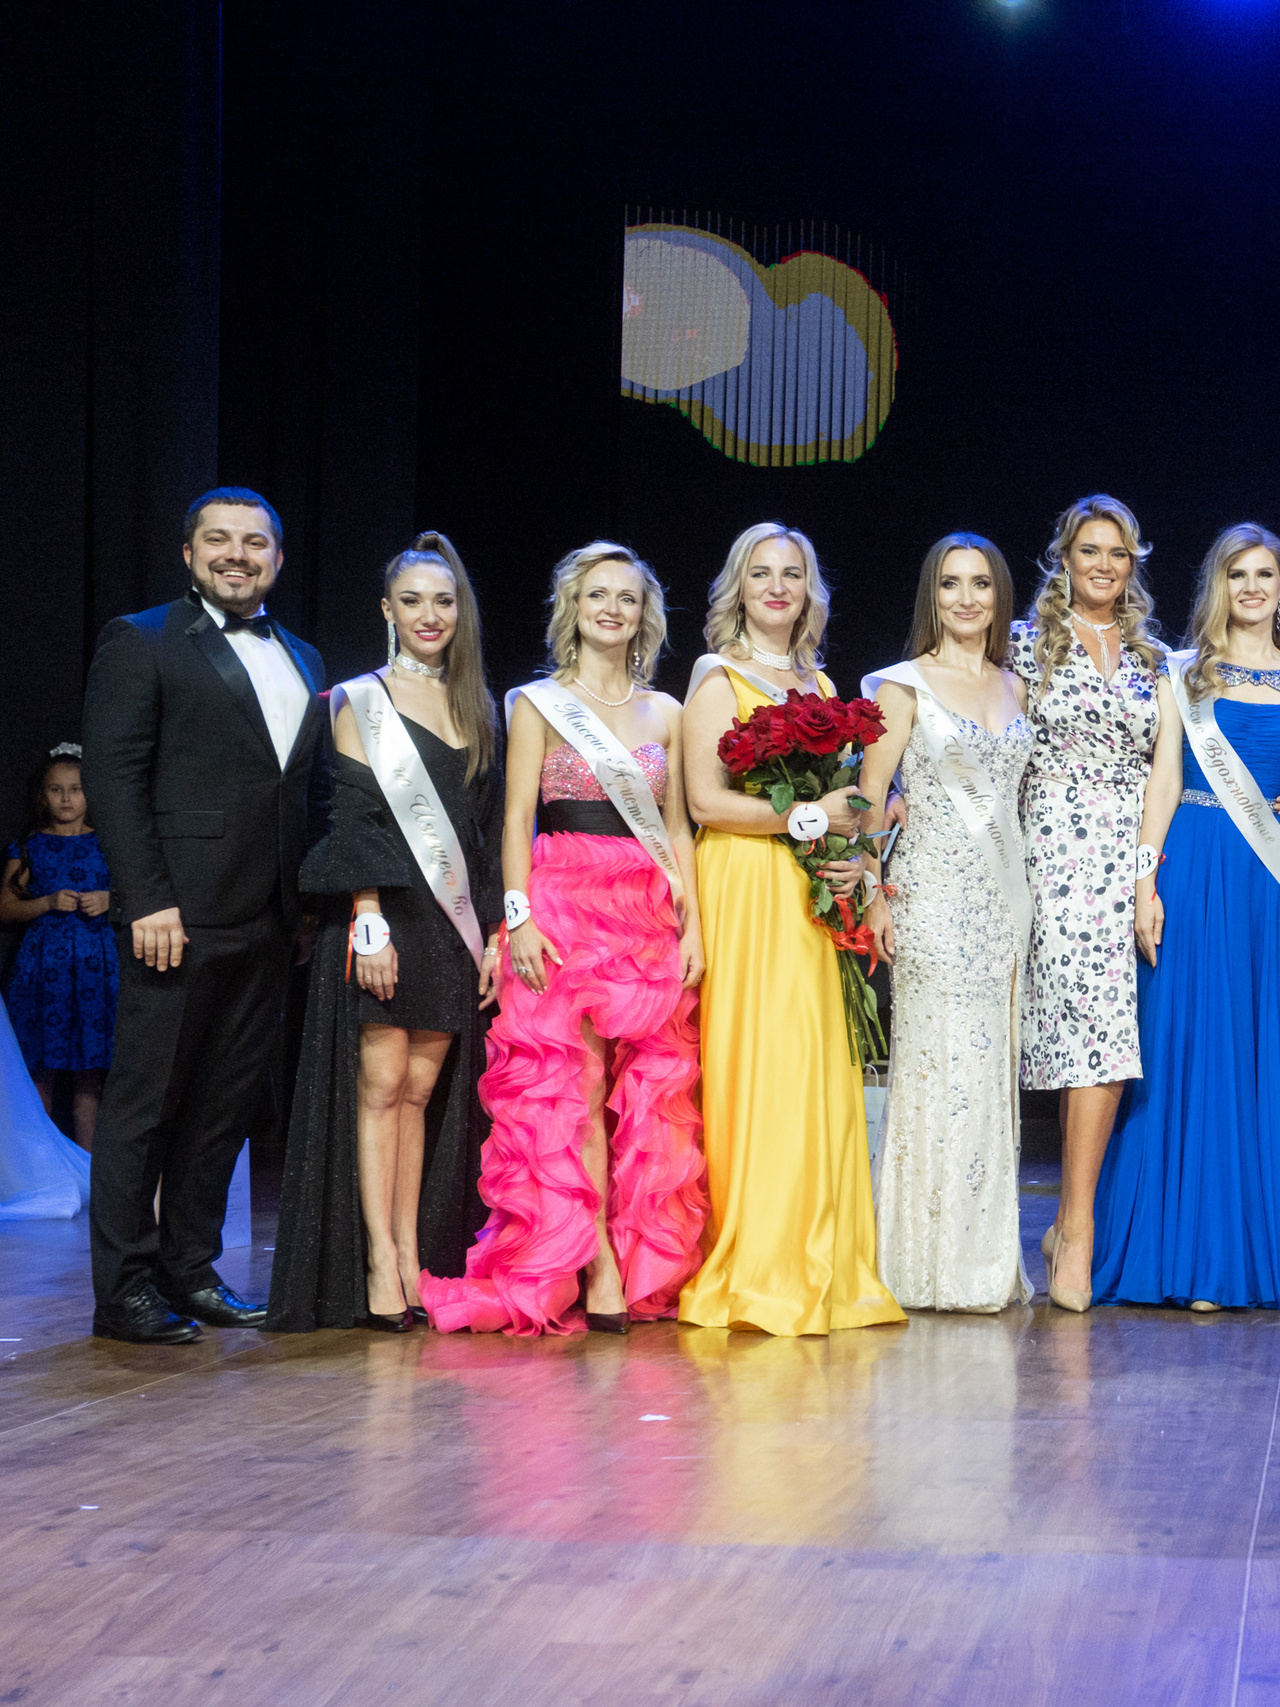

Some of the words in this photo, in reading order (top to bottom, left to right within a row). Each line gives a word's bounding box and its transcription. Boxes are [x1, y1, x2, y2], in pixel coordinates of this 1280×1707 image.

[553, 702, 610, 755] Миссис
[1200, 737, 1275, 845] Вдохновение
[797, 818, 818, 831] 7
[506, 900, 519, 920] 3
[362, 924, 372, 945] 1
